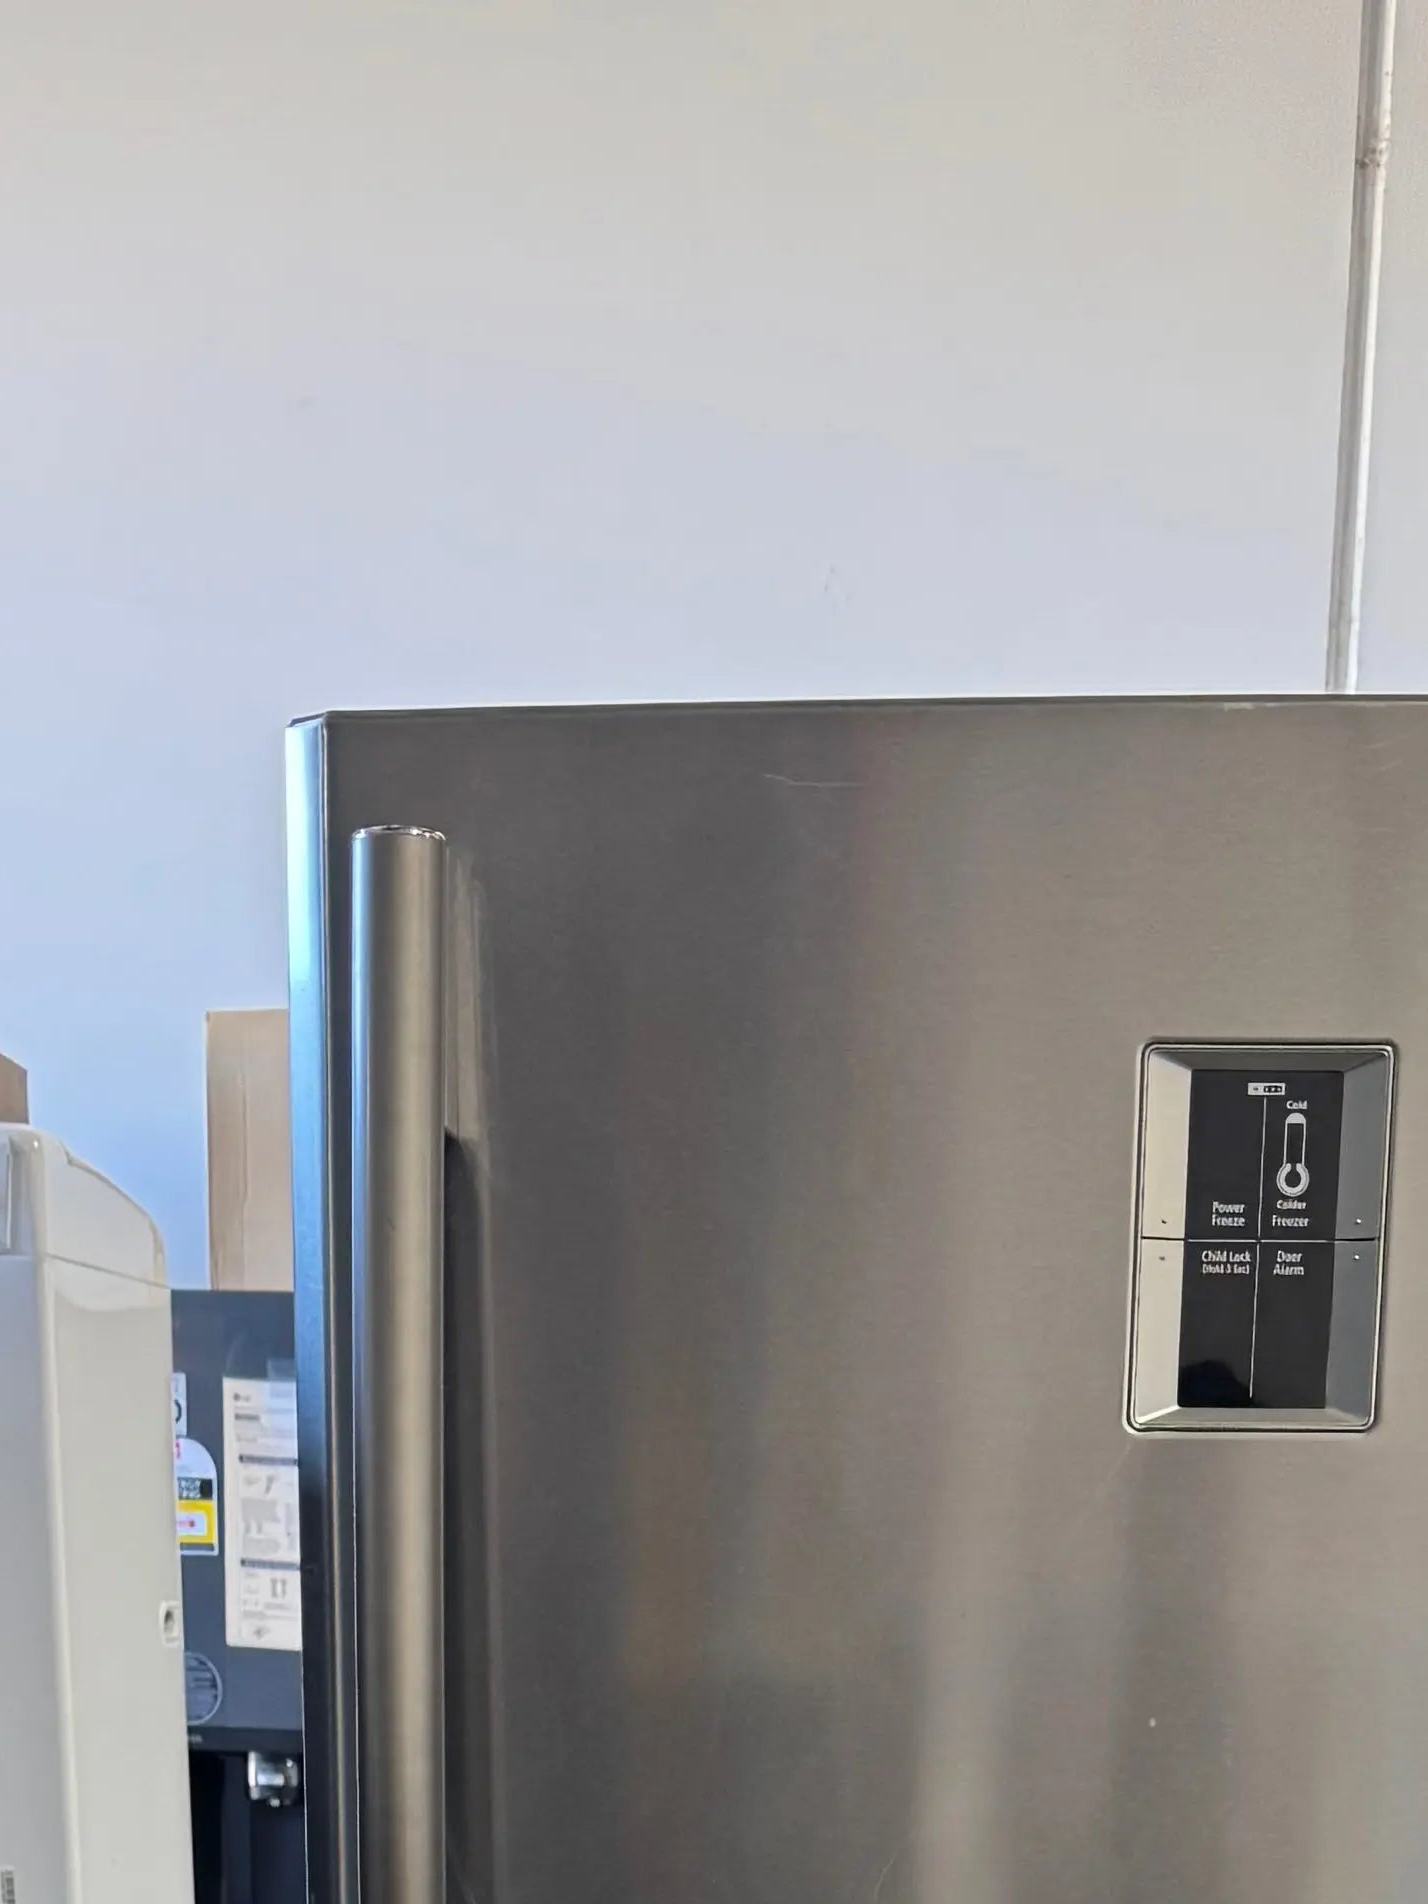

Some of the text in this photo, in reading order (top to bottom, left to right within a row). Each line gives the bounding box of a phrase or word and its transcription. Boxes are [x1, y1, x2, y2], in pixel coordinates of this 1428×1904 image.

[1212, 1201, 1245, 1213] Power
[1212, 1214, 1245, 1227] Freeze
[1272, 1214, 1309, 1227] Freezer
[1201, 1250, 1252, 1262] Child Lock
[1276, 1250, 1303, 1262] Door
[1273, 1263, 1305, 1275] Alarm
